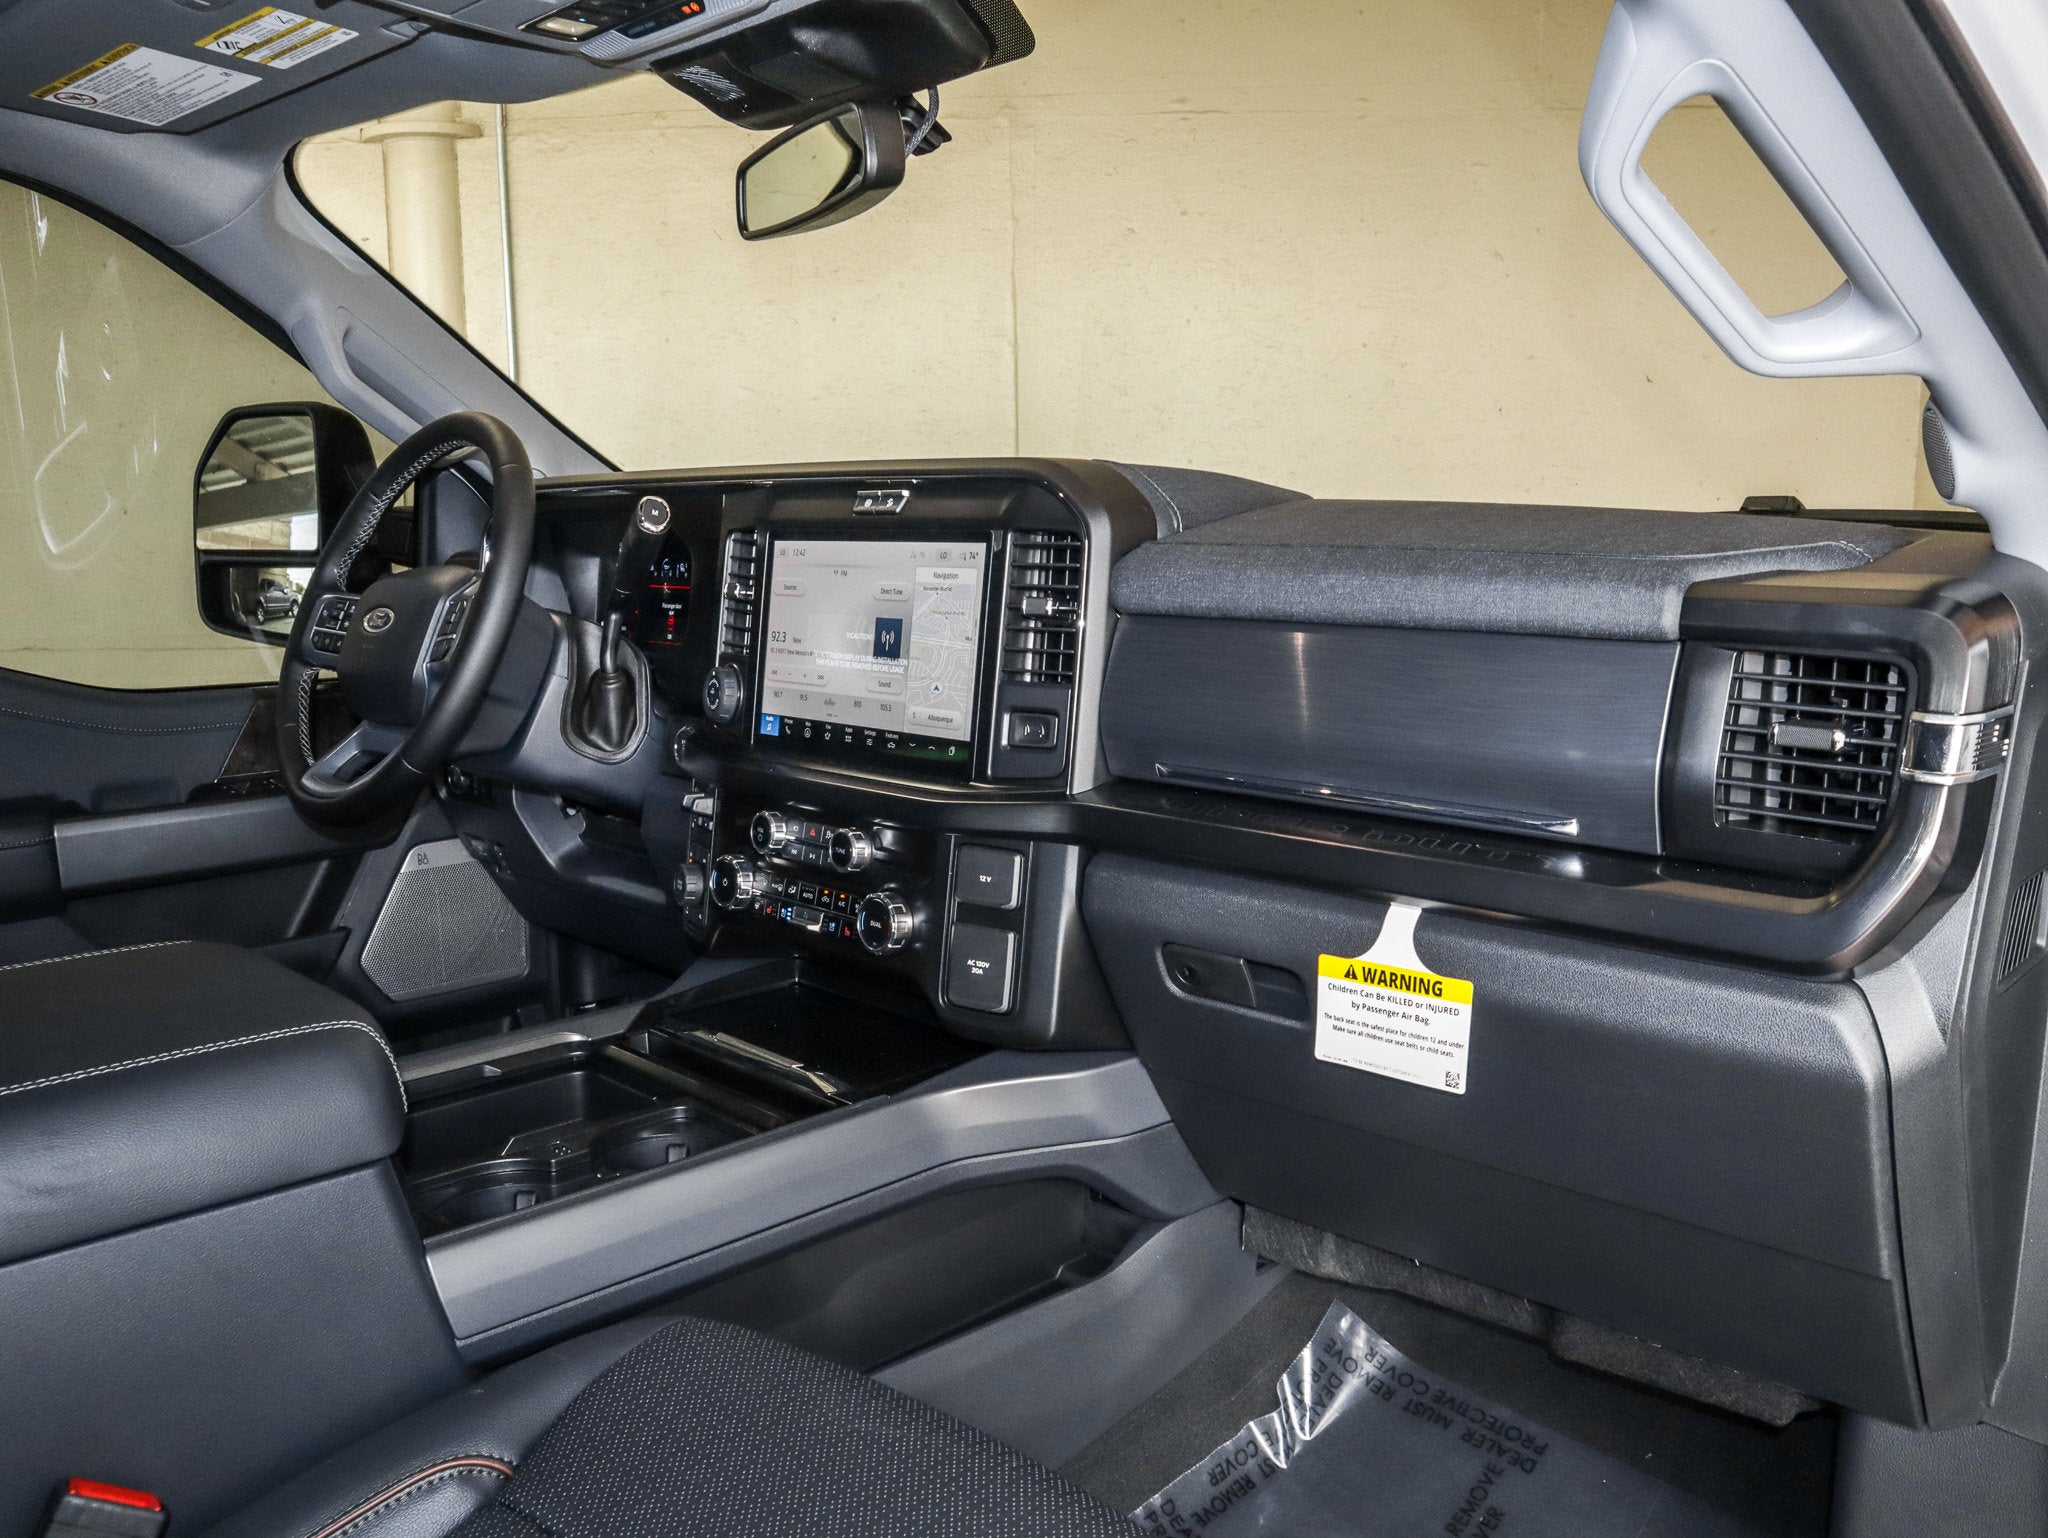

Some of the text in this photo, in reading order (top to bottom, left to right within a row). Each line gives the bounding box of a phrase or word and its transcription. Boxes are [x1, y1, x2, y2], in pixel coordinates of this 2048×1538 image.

[933, 571, 959, 580] Navigation
[880, 587, 903, 596] Direct Tune
[772, 631, 787, 643] 92.3
[928, 714, 954, 723] Albuquerque
[864, 728, 877, 737] Settings
[885, 731, 899, 740] Features
[802, 892, 814, 900] AUTO
[869, 920, 882, 929] DUAL
[967, 959, 990, 969] AC 120V
[971, 967, 983, 975] 20A
[1362, 966, 1443, 997] WARNING
[1328, 982, 1460, 1016] Children Can Be KILLED or INJURED
[1351, 1000, 1360, 1011] by
[1362, 1003, 1400, 1018] Passenger
[1401, 1012, 1412, 1020] Air
[1332, 1024, 1346, 1032] Make
[1364, 1032, 1384, 1042] children
[1394, 1039, 1405, 1047] seat
[1406, 1042, 1418, 1050] belts
[1426, 1047, 1439, 1055] child
[1333, 1014, 1344, 1022] back
[1370, 1024, 1385, 1032] safest
[1385, 1027, 1398, 1035] place
[1408, 1032, 1429, 1041] children
[1448, 1041, 1465, 1049] under
[1323, 1337, 1538, 1475] DEALER MUST REMOVE
[1363, 1345, 1549, 1456] PROTECTIVE COVER
[1207, 1440, 1259, 1487] COVER
[1190, 1473, 1257, 1528] REMOVE
[1444, 1462, 1504, 1537] REMOVE
[1160, 1497, 1201, 1538] DEA
